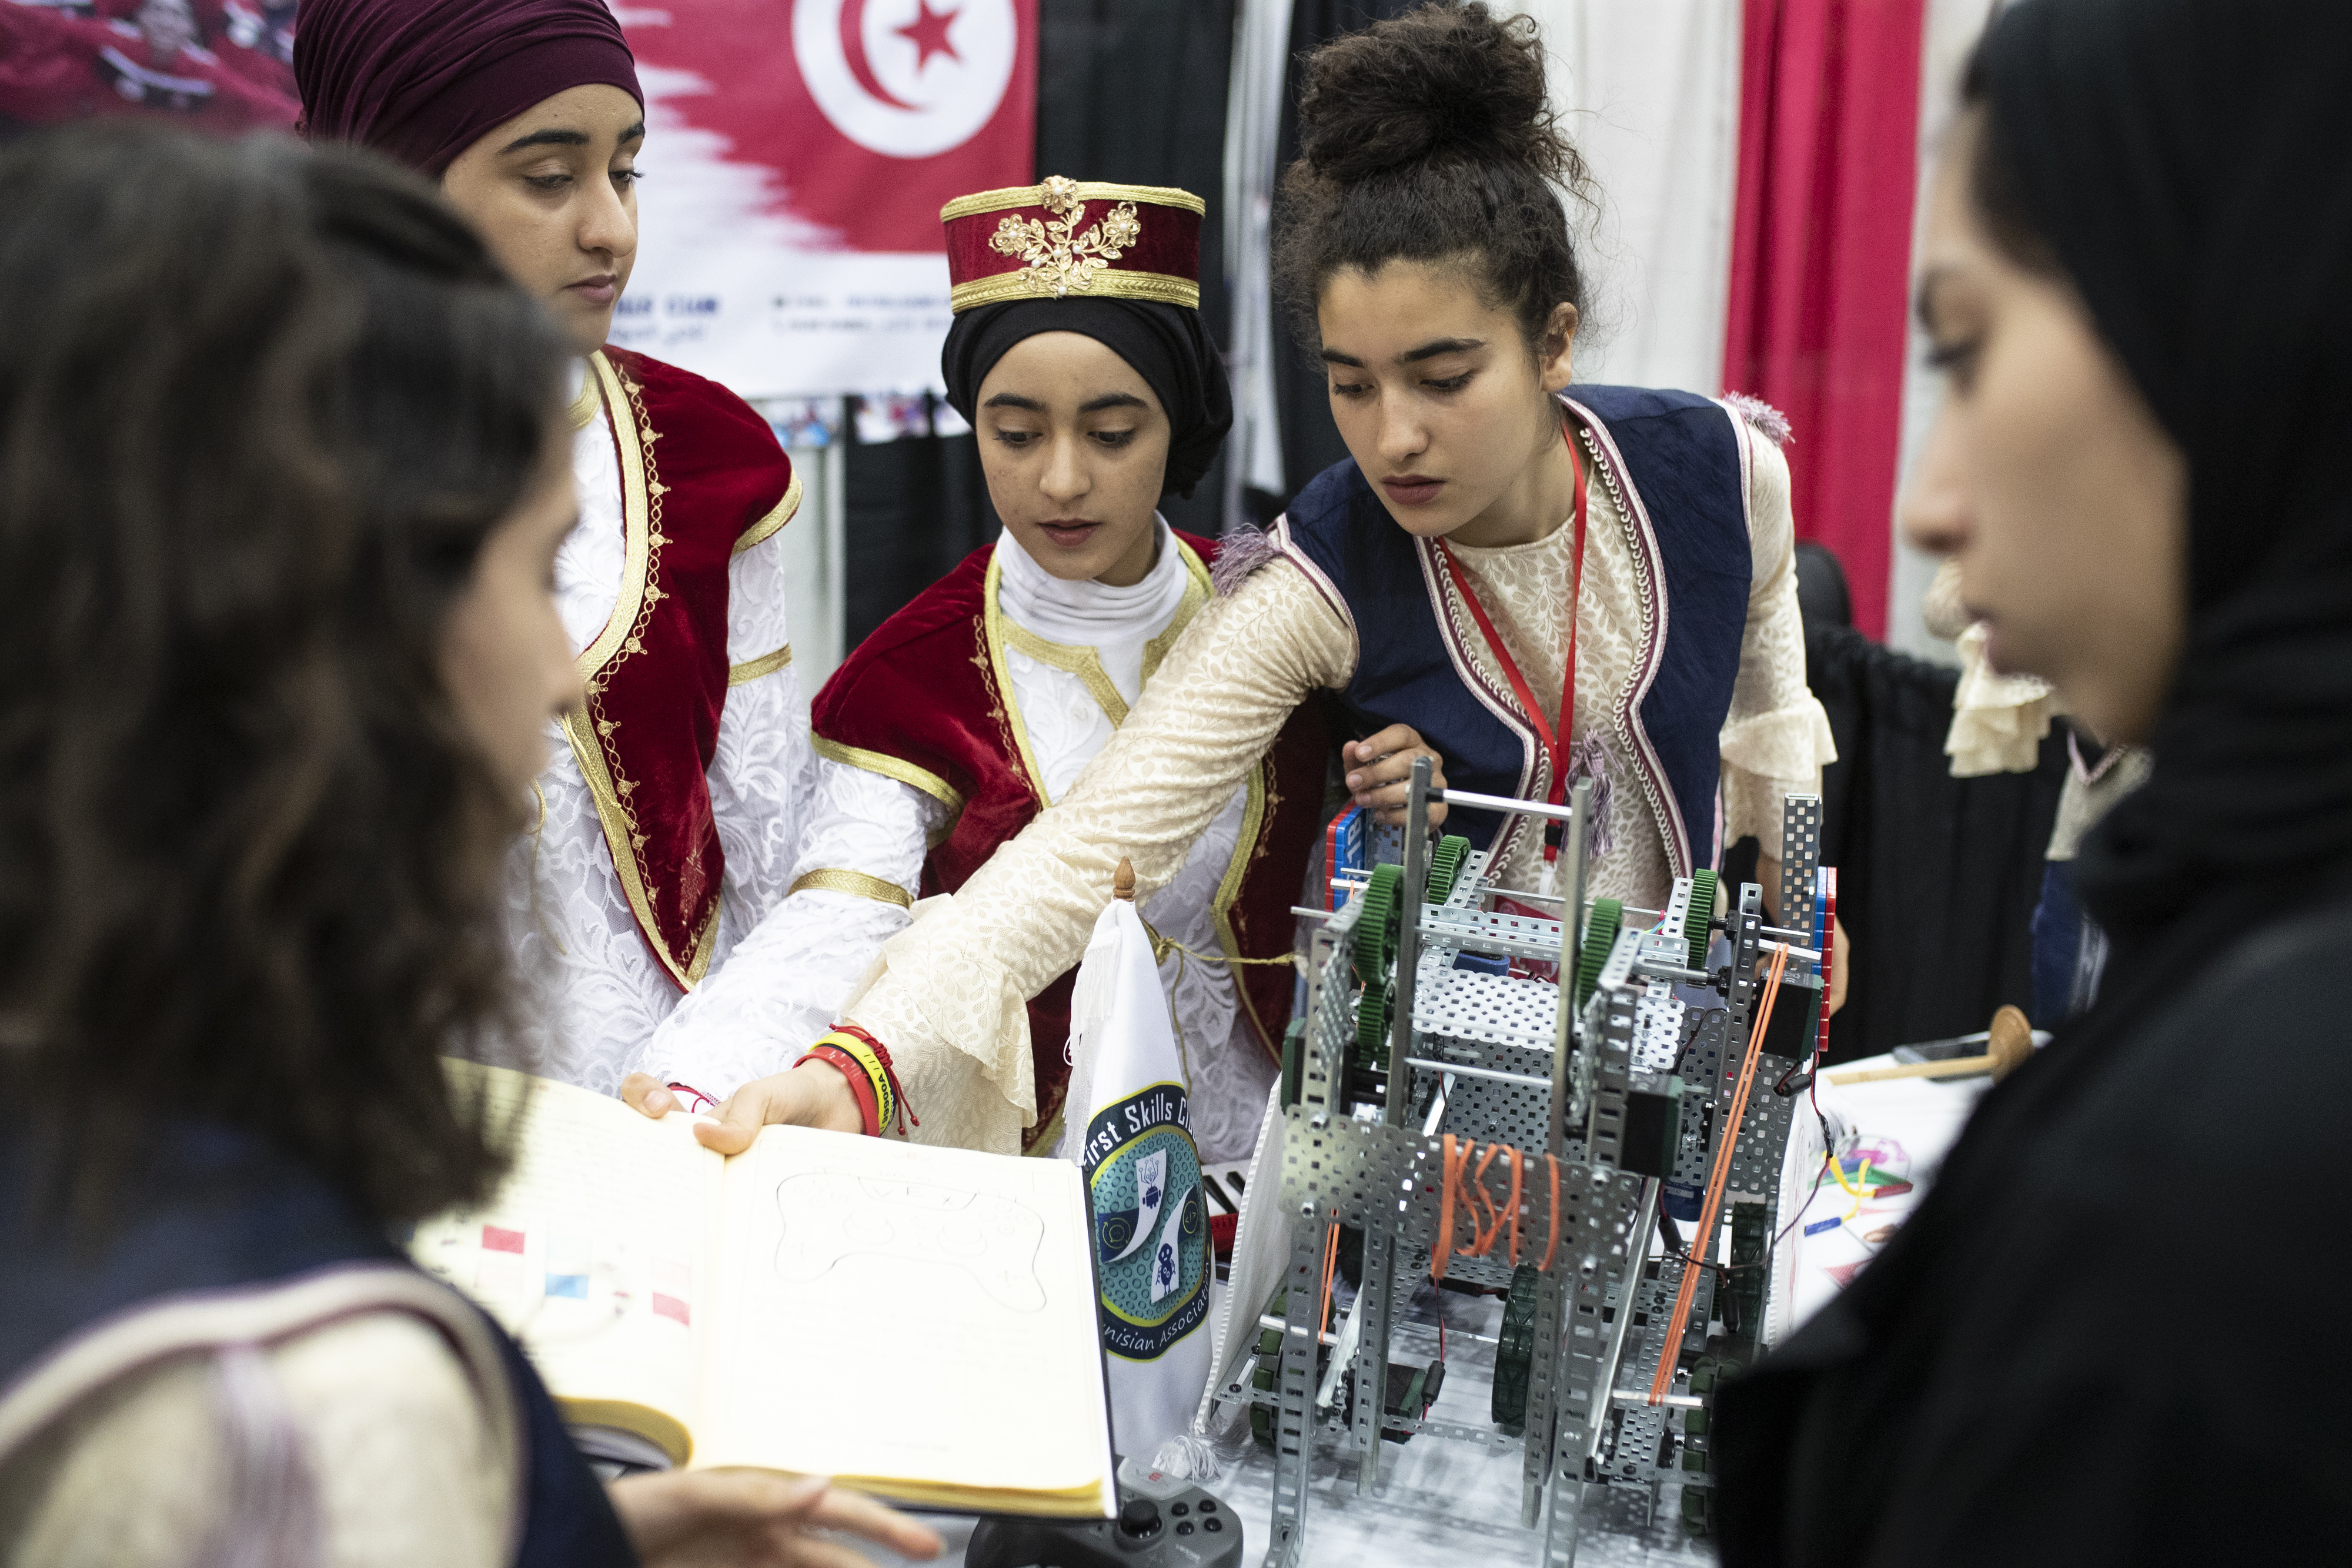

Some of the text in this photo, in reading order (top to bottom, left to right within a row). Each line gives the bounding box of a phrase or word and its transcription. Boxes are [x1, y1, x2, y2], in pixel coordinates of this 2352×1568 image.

[1084, 1121, 1122, 1166] irst
[1124, 1092, 1173, 1134] Skills
[1104, 1325, 1155, 1351] nisian
[1159, 1262, 1210, 1348] Association
